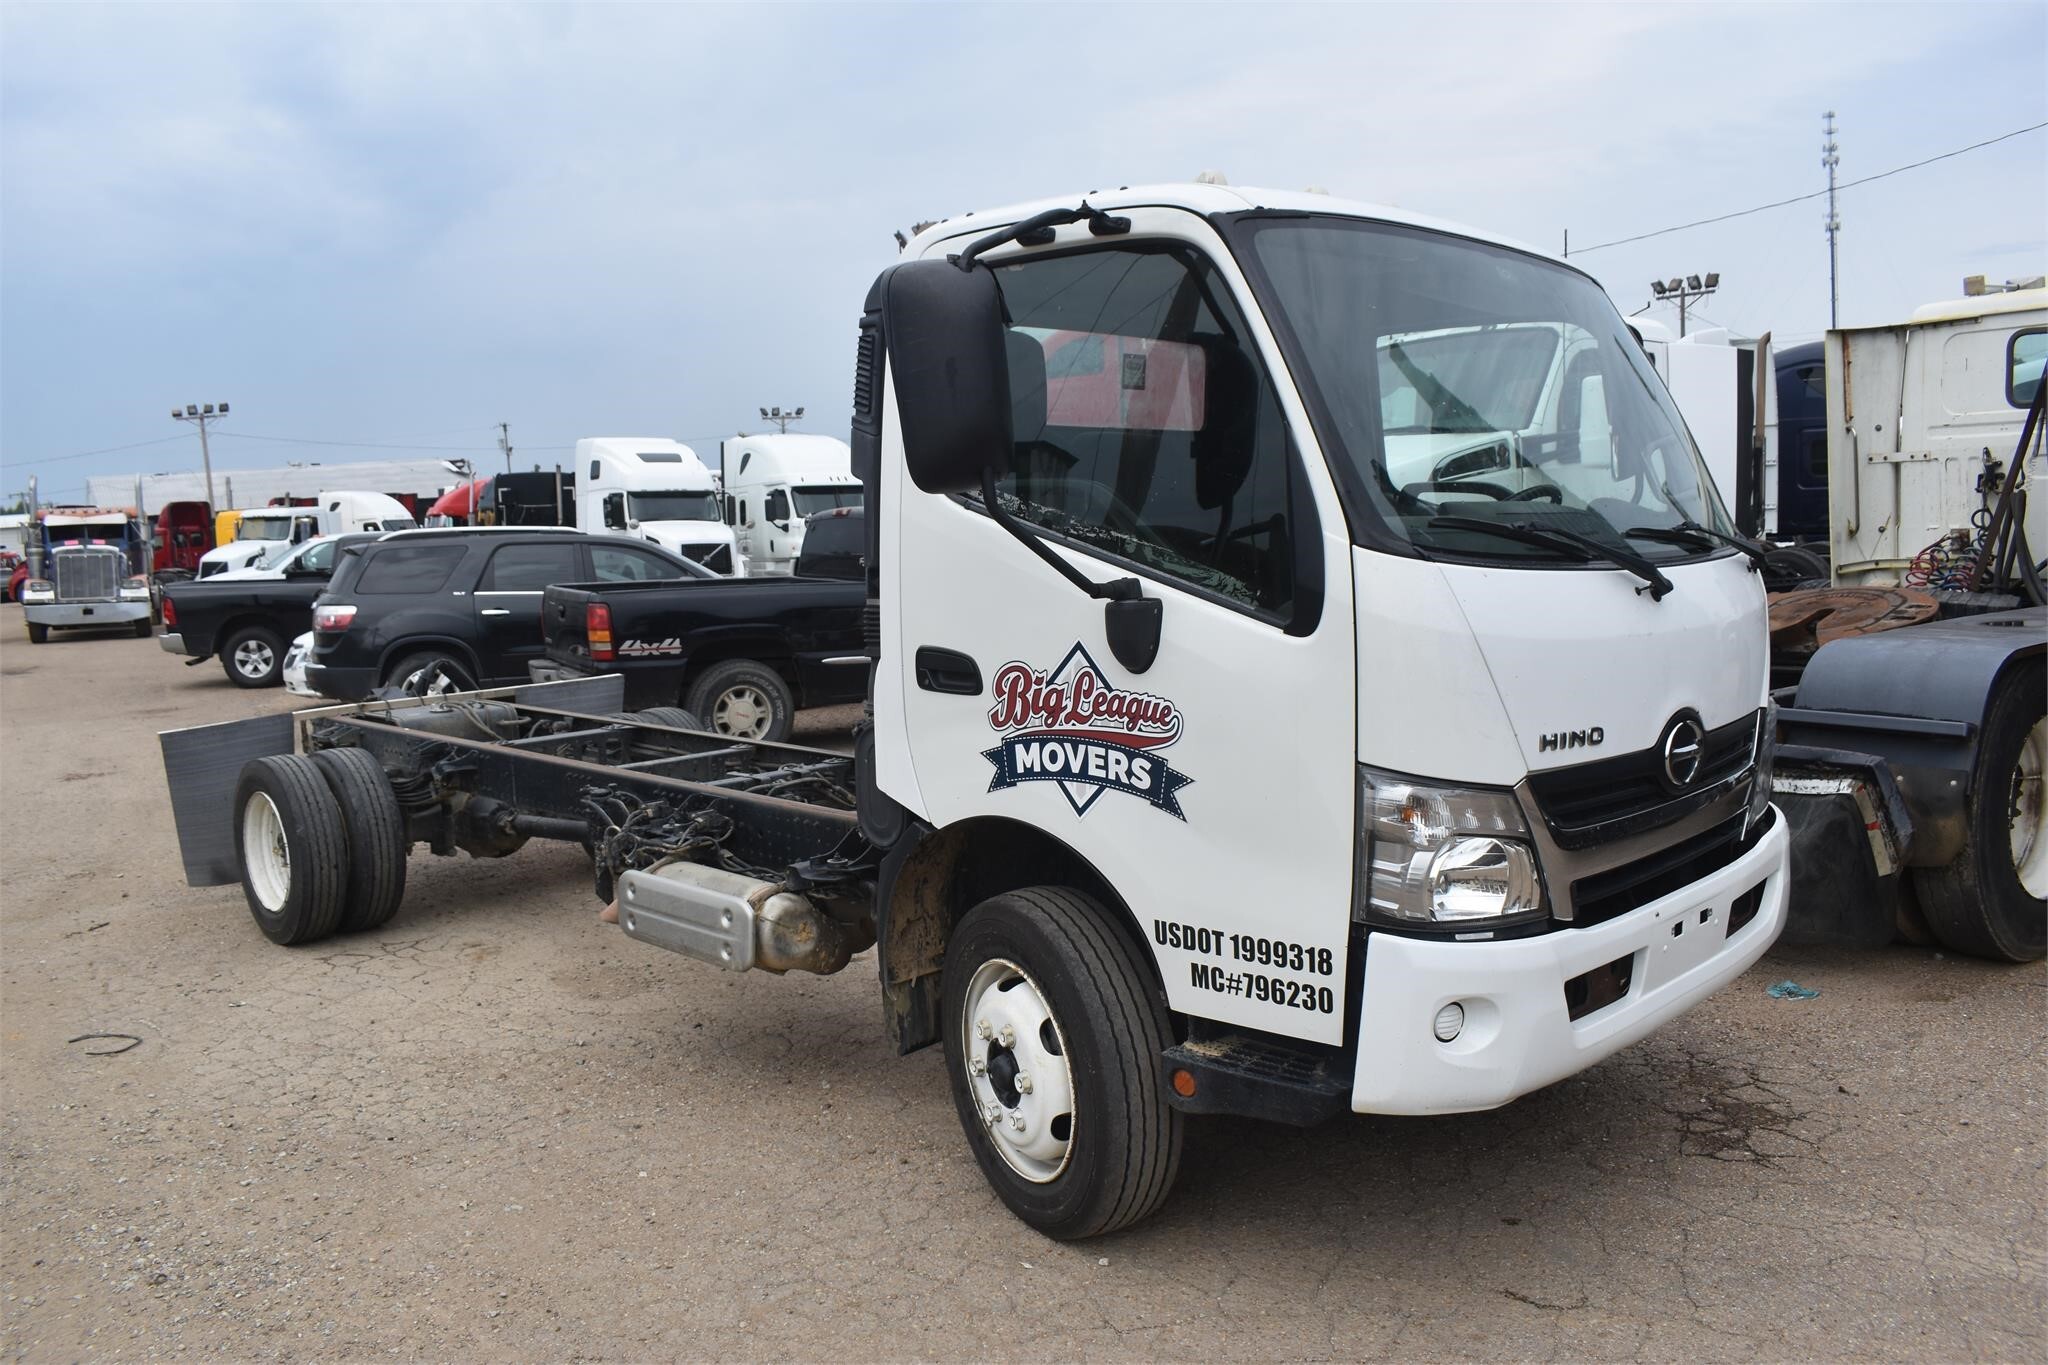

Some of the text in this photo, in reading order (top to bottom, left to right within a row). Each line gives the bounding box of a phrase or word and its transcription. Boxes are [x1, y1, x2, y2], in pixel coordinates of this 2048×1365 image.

[618, 638, 682, 656] 4x4
[989, 662, 1177, 732] Big League
[1539, 727, 1605, 752] HINO
[1014, 742, 1153, 790] MOVERS
[1154, 919, 1334, 976] USDOT 1999318
[1190, 962, 1334, 1014] MC#796230
